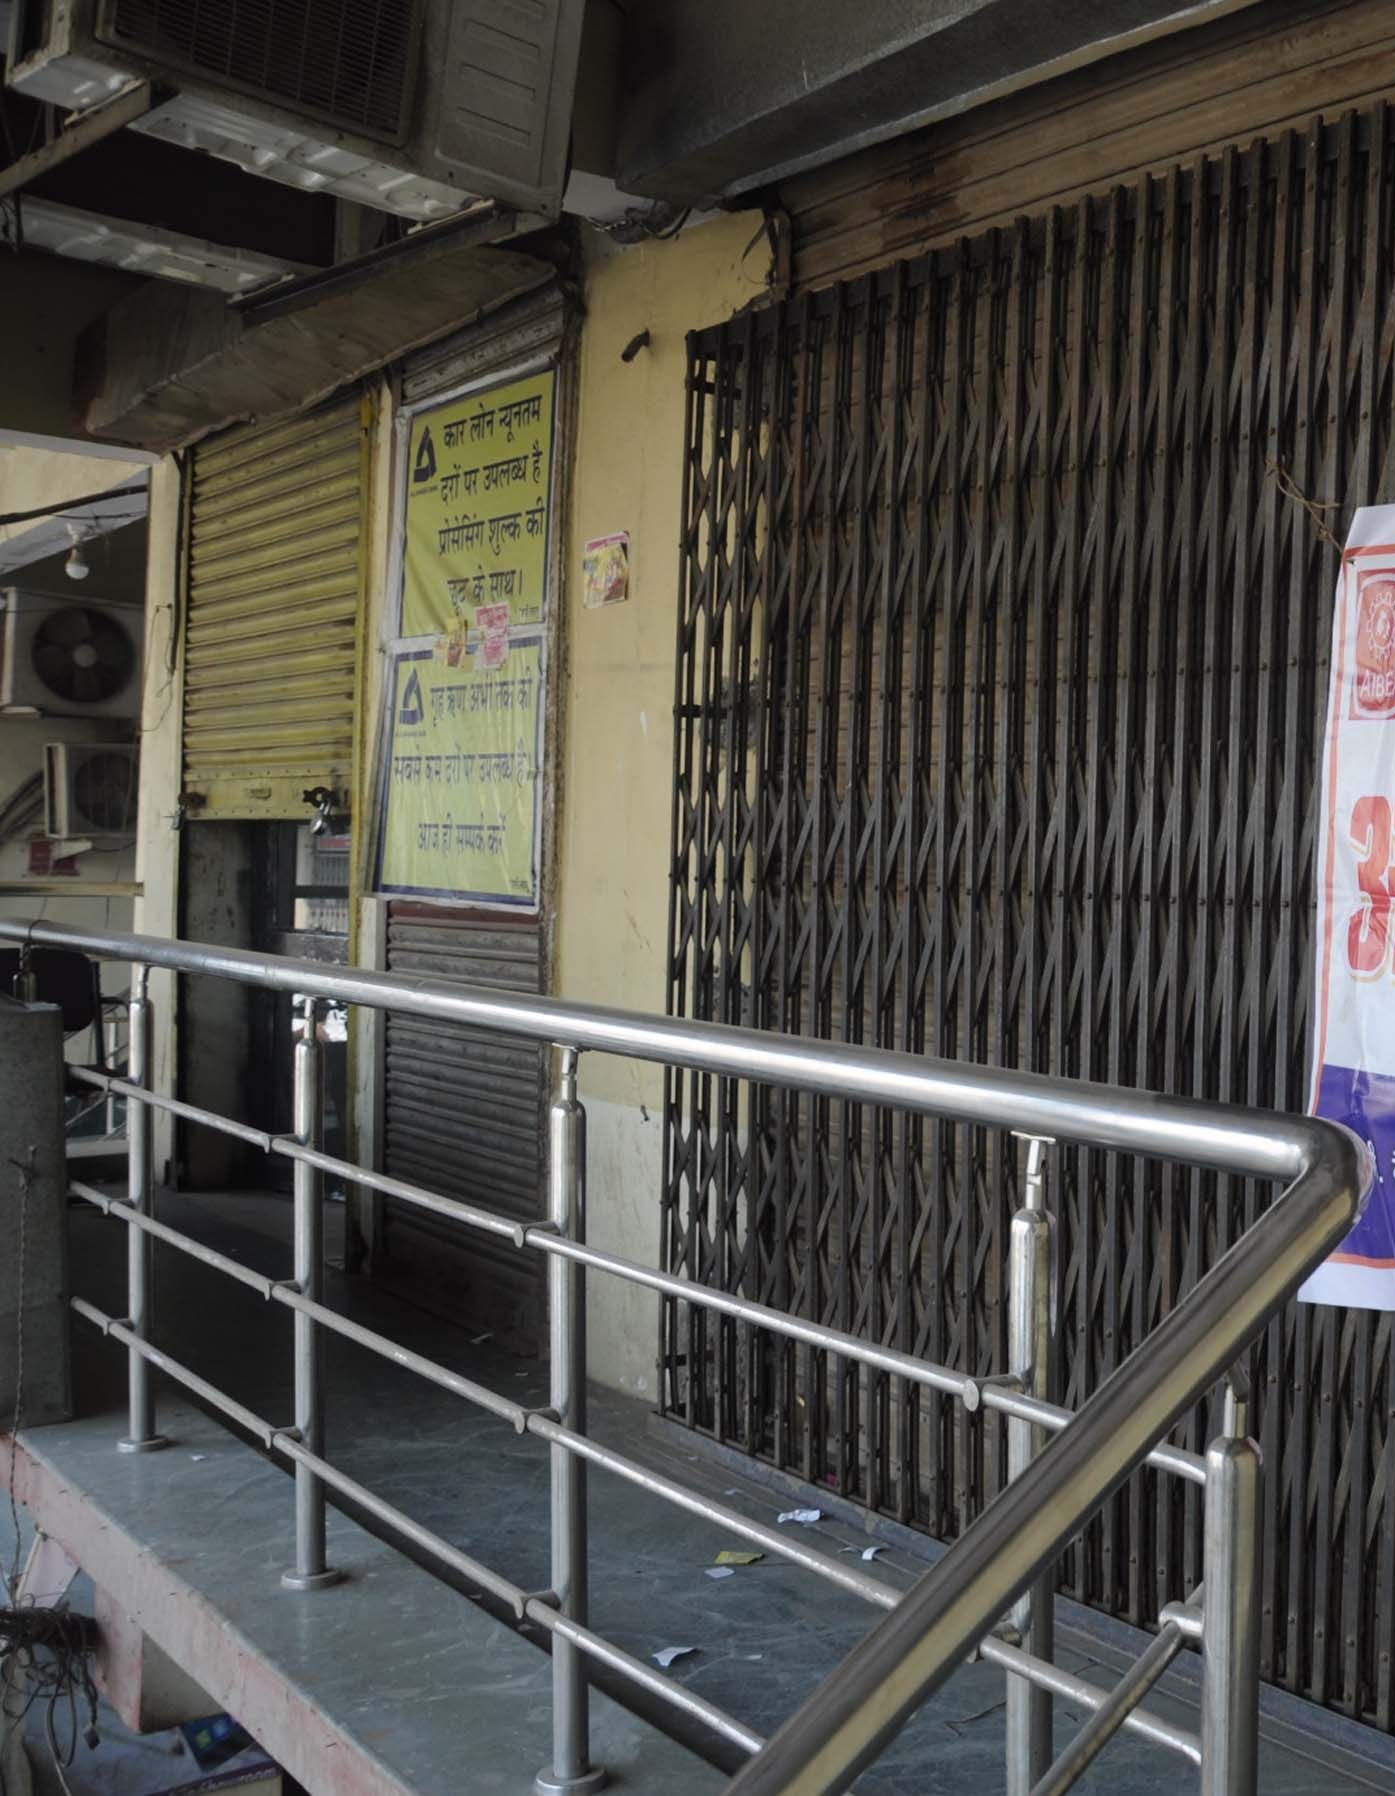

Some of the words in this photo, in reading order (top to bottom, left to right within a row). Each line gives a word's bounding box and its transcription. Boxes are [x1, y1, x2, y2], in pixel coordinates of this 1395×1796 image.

[443, 420, 466, 448] कार
[470, 403, 495, 442] लोन
[499, 395, 542, 442] न्यूनतम
[440, 464, 460, 506] दरों
[464, 468, 479, 496] पर
[483, 455, 528, 491] उपलब्ध
[488, 512, 522, 555] शुल्क
[526, 497, 545, 536] की
